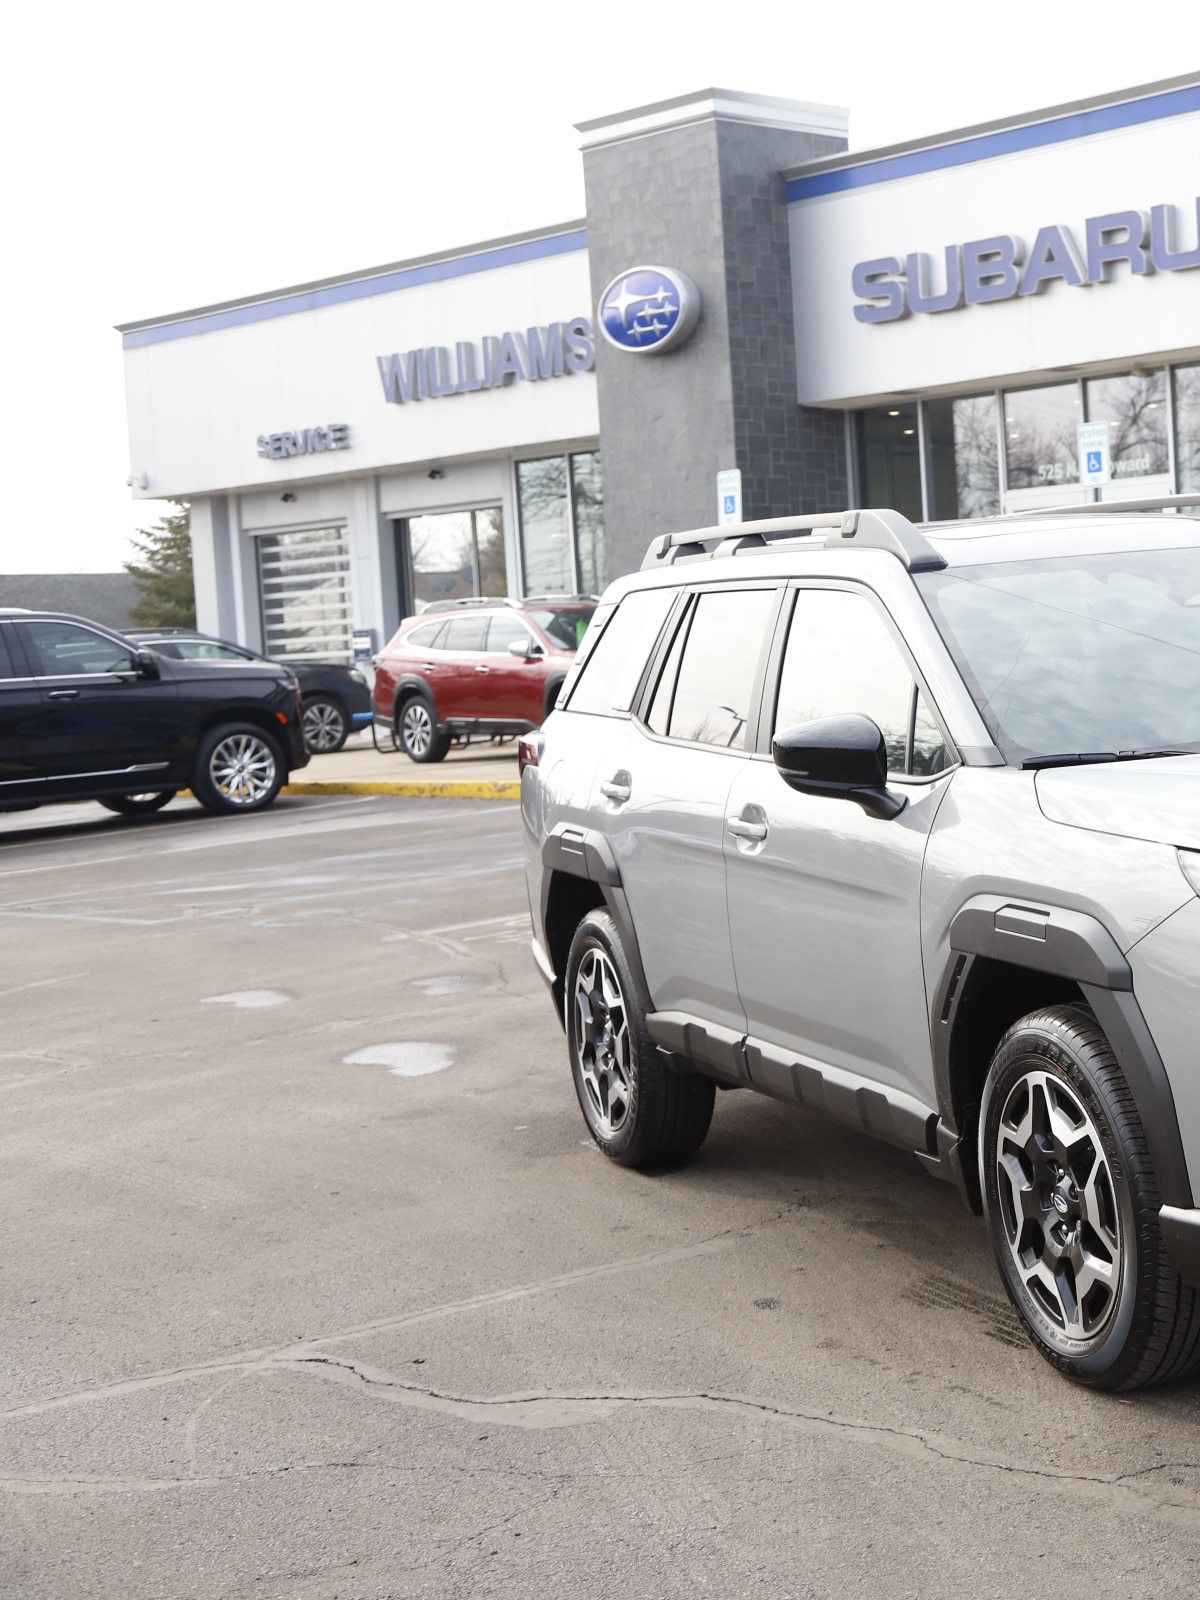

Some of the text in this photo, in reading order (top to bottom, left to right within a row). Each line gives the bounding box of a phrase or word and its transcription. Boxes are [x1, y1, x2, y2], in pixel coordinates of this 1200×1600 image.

[376, 318, 595, 403] WILLIAMS
[257, 422, 351, 459] SERVICE
[1038, 463, 1063, 480] 525
[1110, 454, 1150, 474] oward
